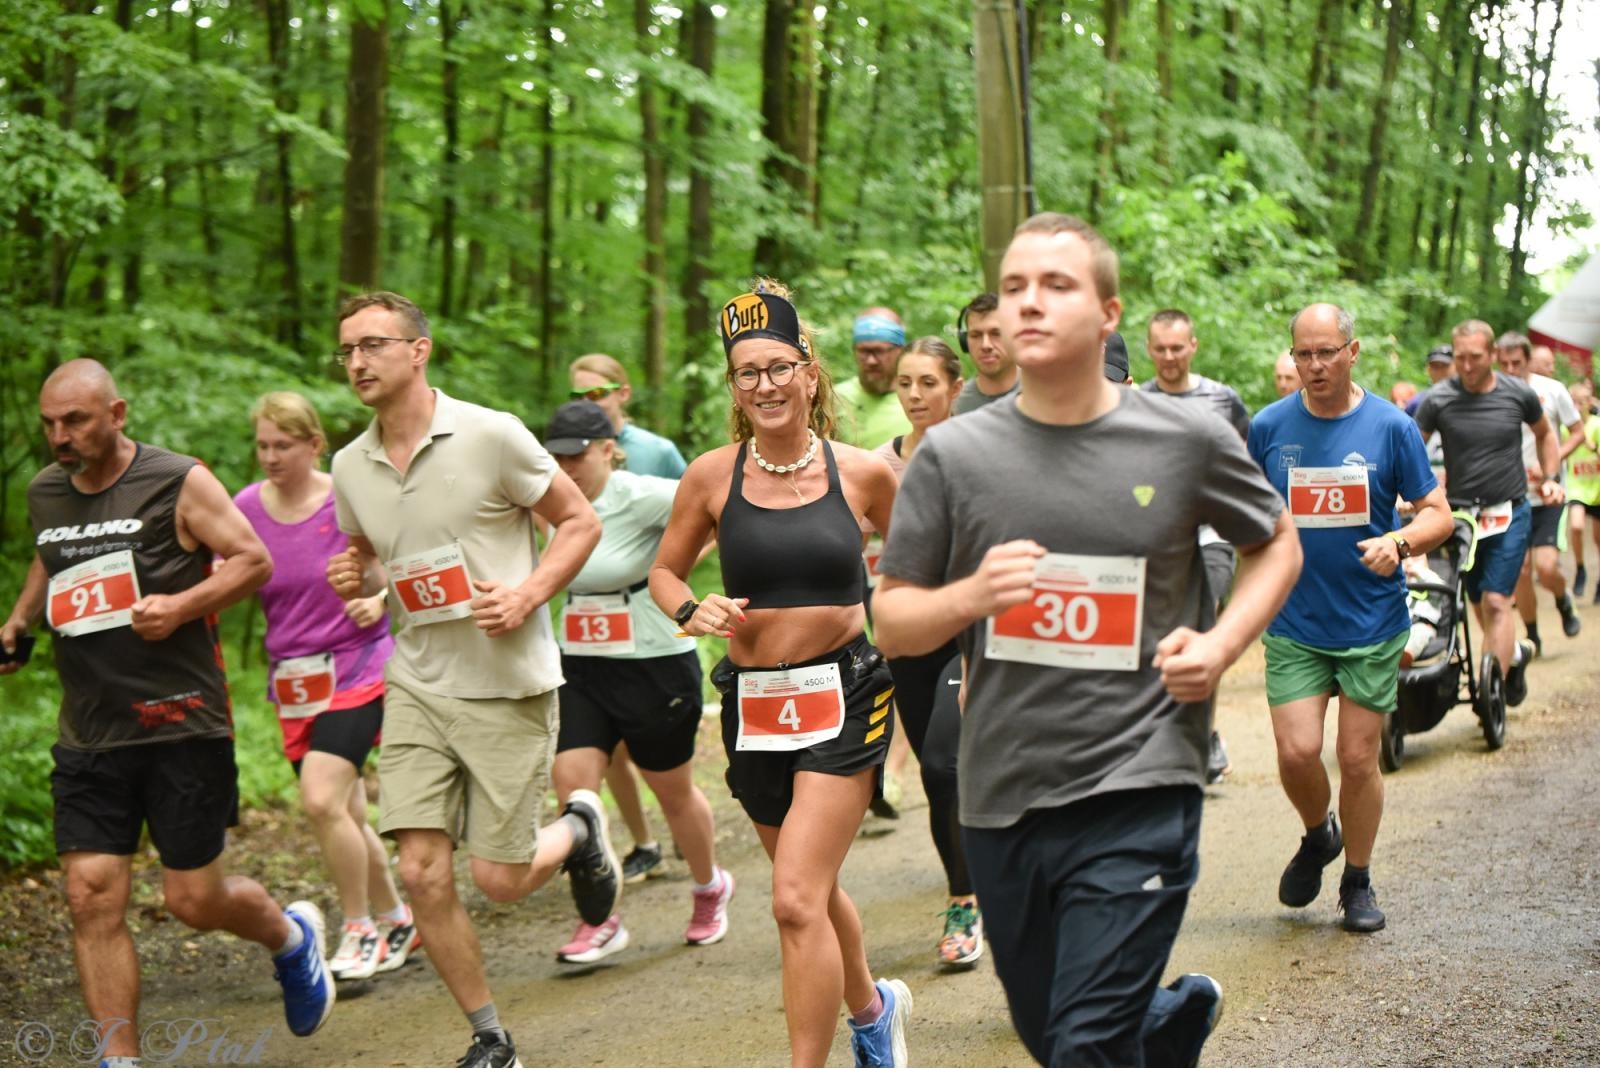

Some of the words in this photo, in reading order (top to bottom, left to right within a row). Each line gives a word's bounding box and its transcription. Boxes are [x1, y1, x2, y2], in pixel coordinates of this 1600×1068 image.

[1310, 487, 1346, 513] 78
[37, 519, 143, 545] SOLANO
[70, 582, 112, 618] 91
[412, 575, 447, 607] 85
[578, 616, 611, 641] 13
[1032, 592, 1099, 641] 30
[291, 679, 309, 704] 5
[803, 677, 825, 687] 4500
[826, 675, 835, 684] M
[777, 698, 802, 731] 4
